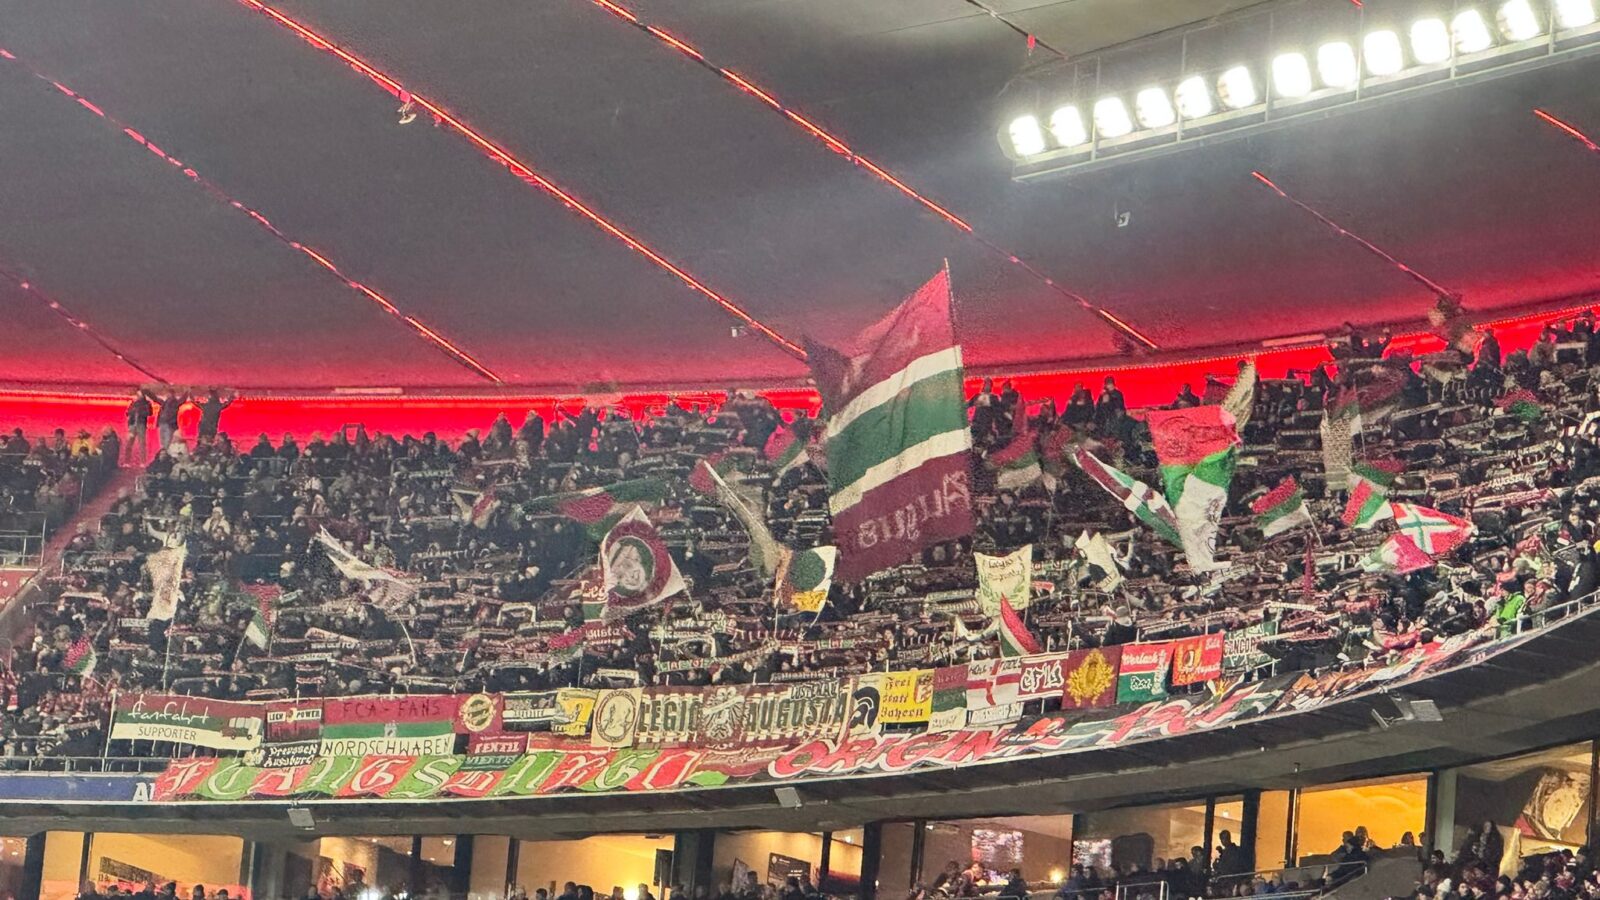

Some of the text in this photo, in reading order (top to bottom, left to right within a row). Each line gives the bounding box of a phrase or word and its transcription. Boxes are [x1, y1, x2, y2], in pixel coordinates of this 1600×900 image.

[580, 580, 607, 601] Leg
[296, 710, 321, 719] POWER
[637, 698, 702, 733] LEGIO
[746, 693, 848, 732] AUGUSTA
[138, 726, 197, 741] SUPPORTER
[323, 737, 451, 756] NORDSCHWABEN
[474, 741, 520, 754] TEXTIL
